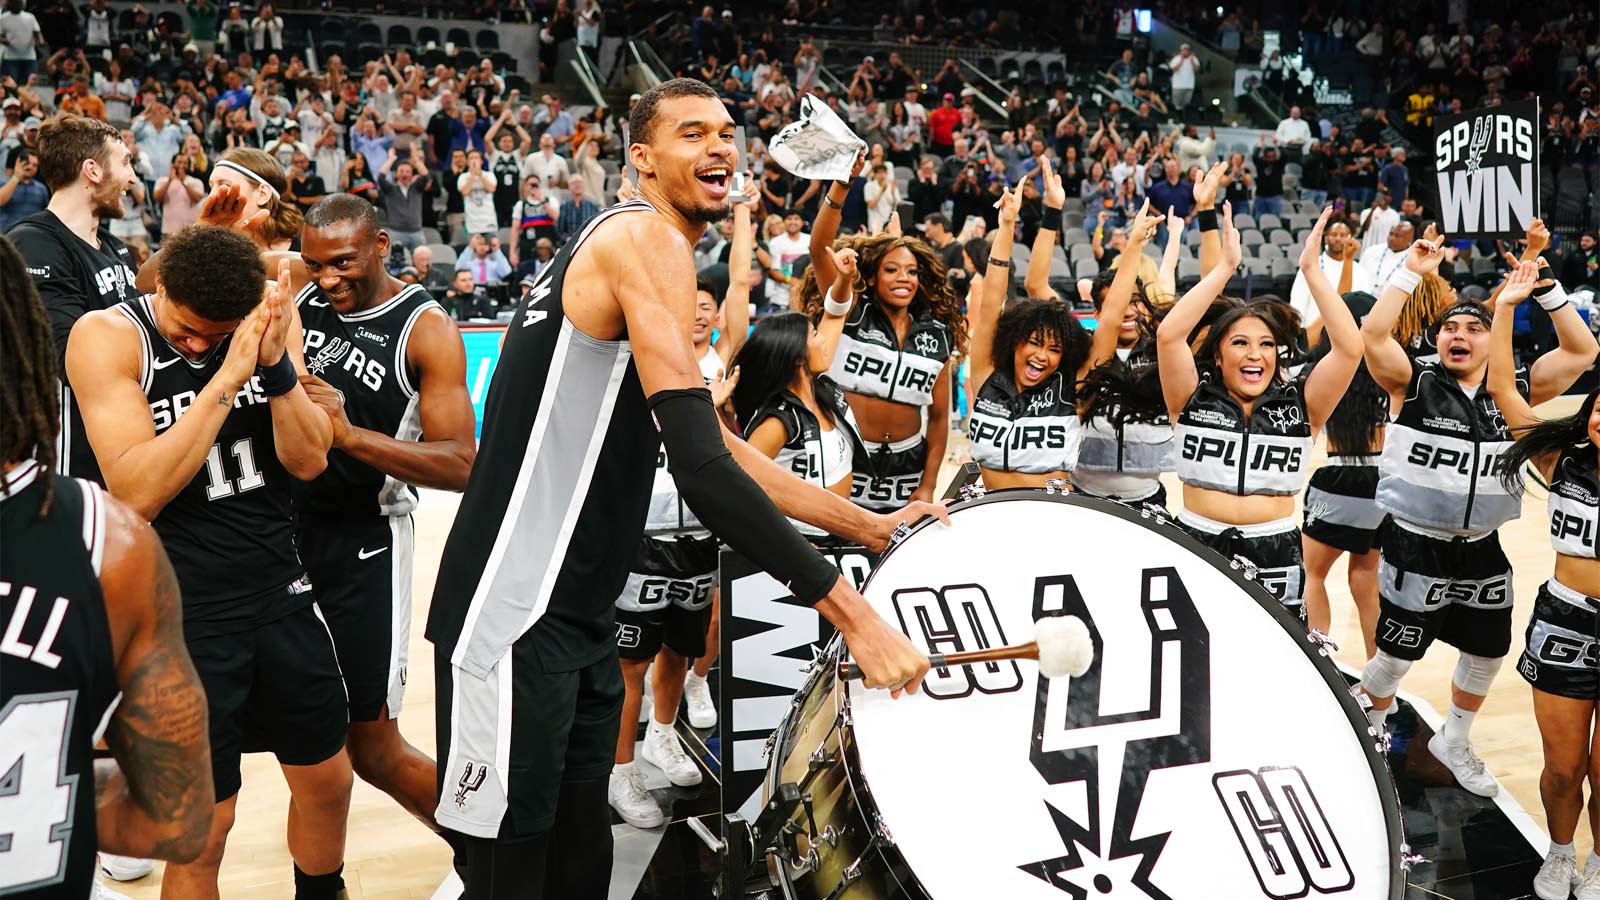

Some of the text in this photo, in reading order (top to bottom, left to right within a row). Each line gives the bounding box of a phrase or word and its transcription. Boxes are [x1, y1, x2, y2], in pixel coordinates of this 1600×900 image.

[1436, 114, 1533, 175] SPURS
[1437, 163, 1534, 234] WIN
[359, 330, 385, 343] LEDGER
[302, 328, 386, 392] PURS
[844, 352, 937, 393] SPURS
[970, 418, 1066, 450] SPURS
[204, 437, 266, 501] 11
[1182, 434, 1303, 473] SPURS
[850, 476, 921, 501] GSG
[638, 576, 713, 605] GSG
[1424, 576, 1508, 607] GSG
[1382, 618, 1423, 648] 73
[1538, 632, 1599, 669] GS
[1212, 766, 1355, 900] GO
